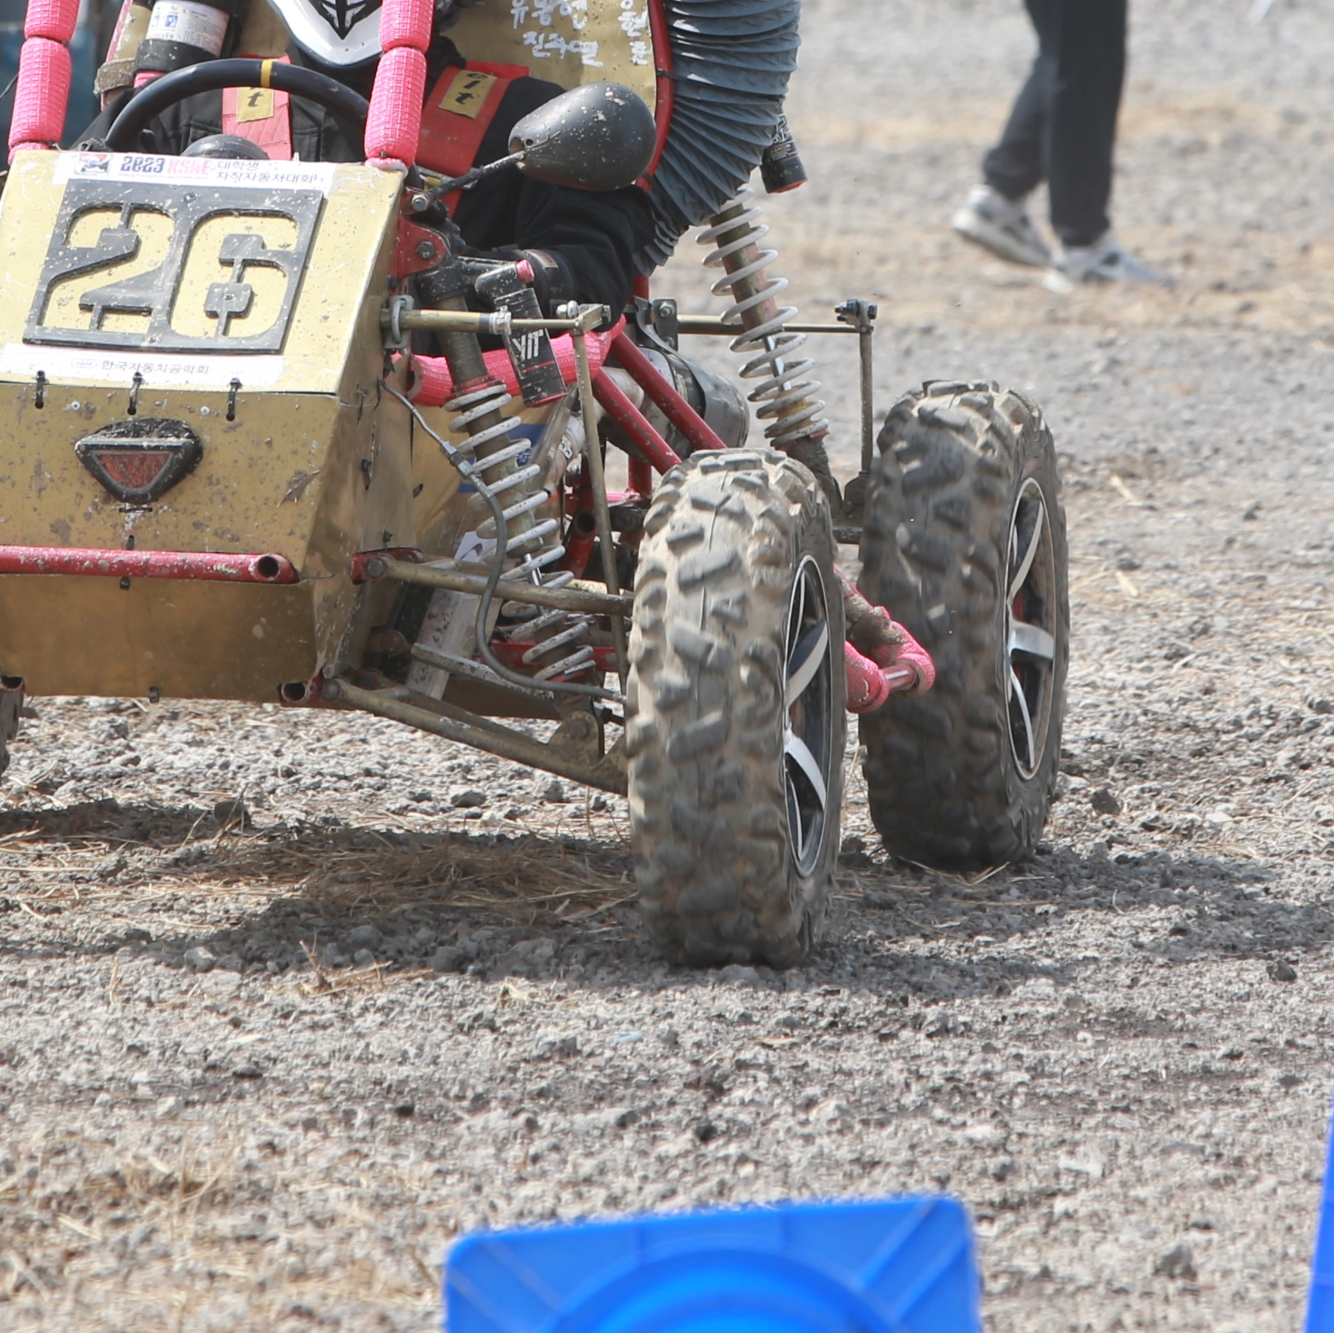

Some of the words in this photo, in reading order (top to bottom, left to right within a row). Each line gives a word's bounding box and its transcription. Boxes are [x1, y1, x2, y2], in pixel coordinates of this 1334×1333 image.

[120, 155, 165, 173] 2023
[166, 157, 210, 176] KSAE
[216, 160, 259, 171] 대학생
[36, 201, 300, 340] 26
